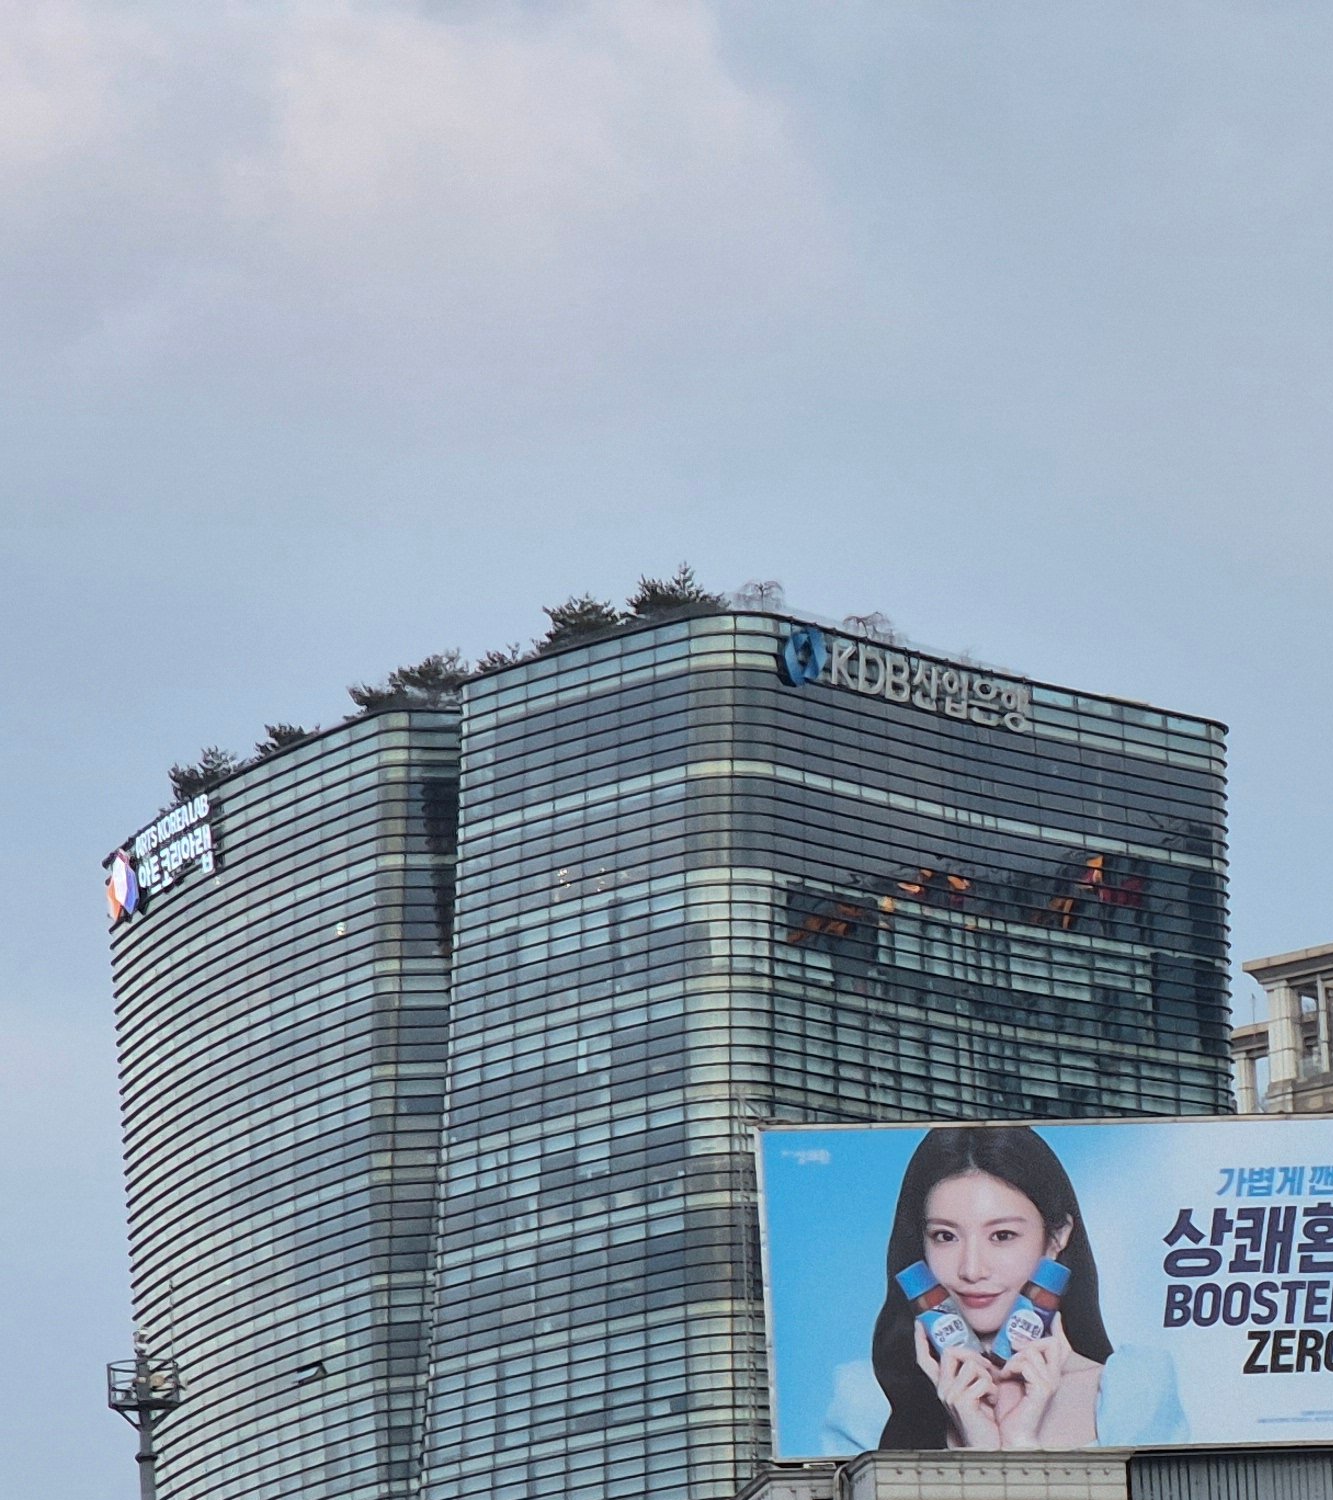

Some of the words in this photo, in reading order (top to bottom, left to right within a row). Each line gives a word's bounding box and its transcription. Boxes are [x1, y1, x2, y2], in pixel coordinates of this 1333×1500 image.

[831, 640, 1031, 733] KDB산업은행
[135, 825, 158, 859] ARTS
[157, 804, 190, 843] KOREA
[187, 793, 210, 823] LAB
[1216, 1165, 1304, 1197] 가볍게
